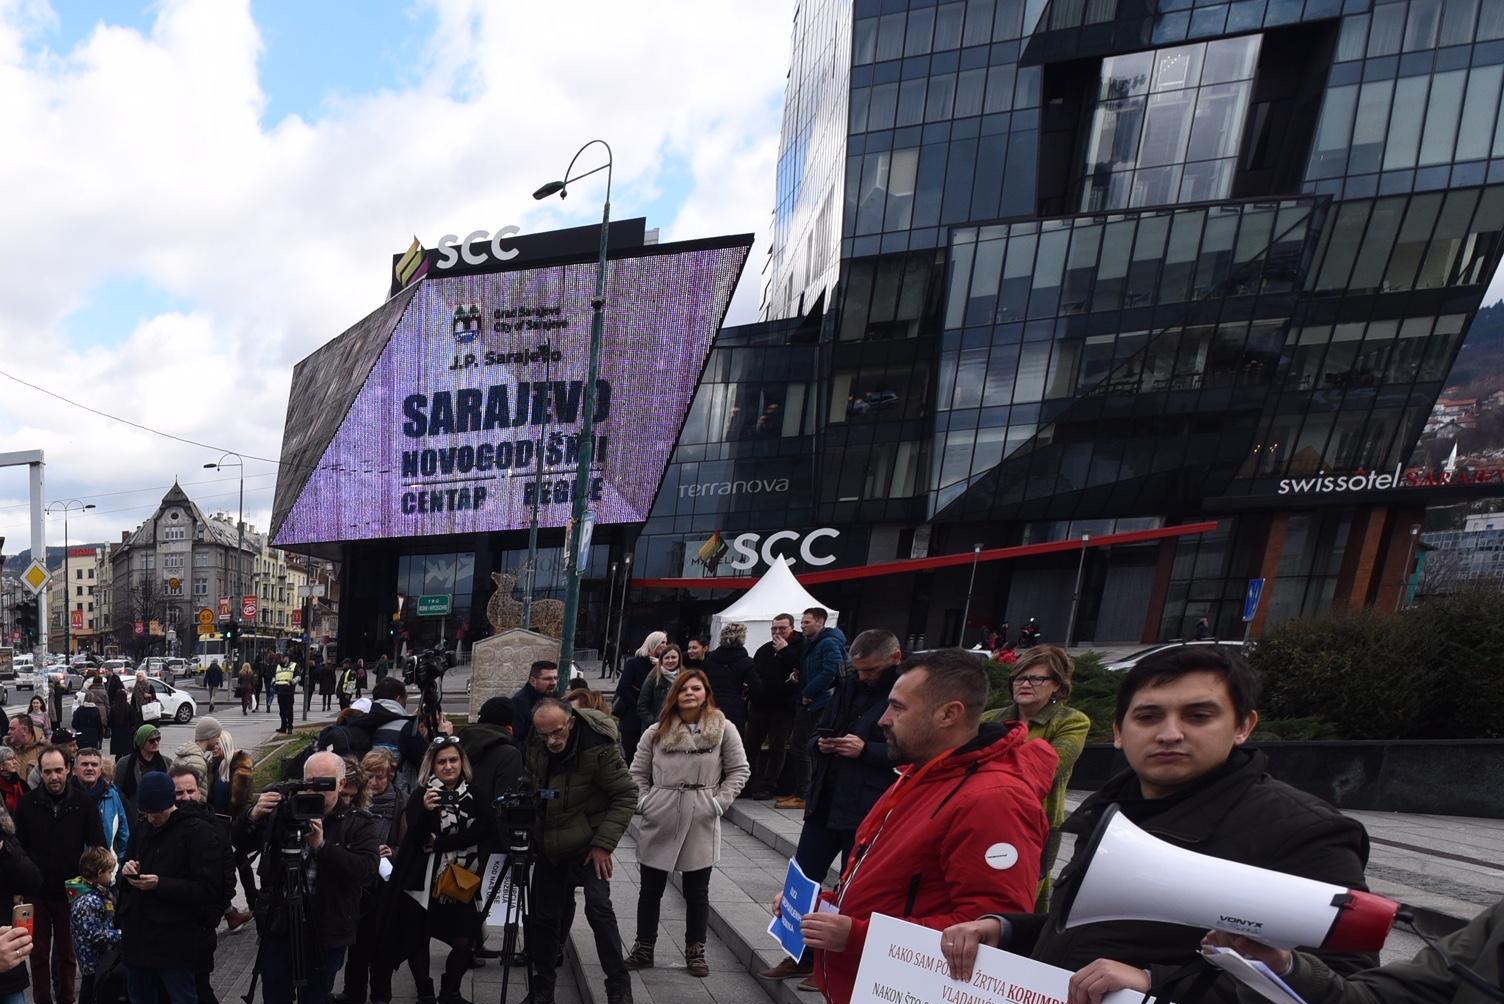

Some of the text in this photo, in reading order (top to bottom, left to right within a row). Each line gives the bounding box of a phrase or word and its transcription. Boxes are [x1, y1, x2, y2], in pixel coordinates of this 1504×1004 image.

[436, 225, 521, 269] SCC
[402, 379, 612, 438] SARAJEVO
[402, 431, 608, 478] NOVOGODŠNI
[680, 478, 790, 498] terranova
[731, 527, 840, 570] SCC
[1219, 914, 1263, 928] VONYX
[888, 944, 913, 963] KAKO
[914, 952, 934, 971] SAM
[973, 969, 1006, 996] ŽRTVA
[872, 982, 903, 1004] NAKON
